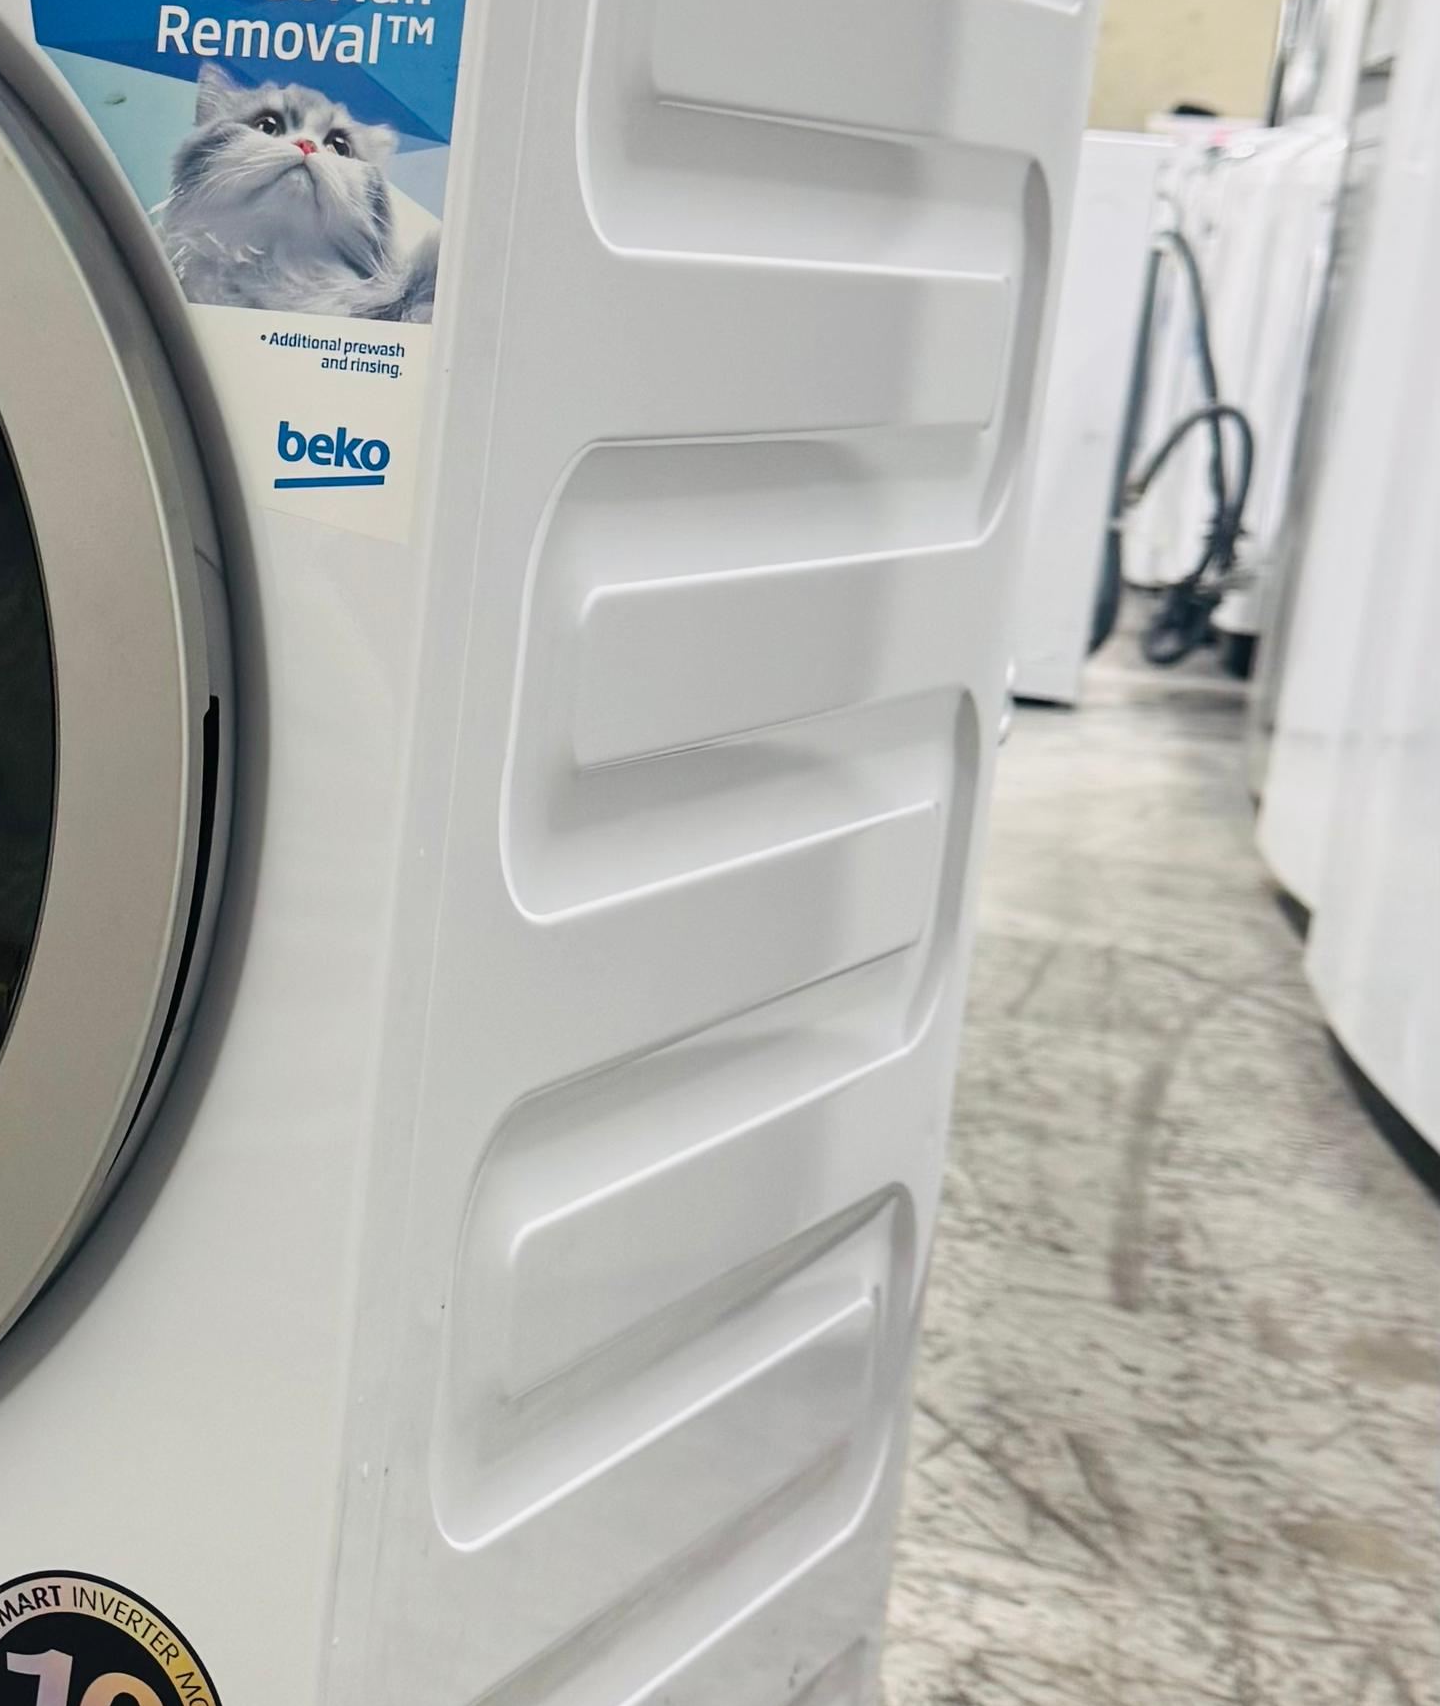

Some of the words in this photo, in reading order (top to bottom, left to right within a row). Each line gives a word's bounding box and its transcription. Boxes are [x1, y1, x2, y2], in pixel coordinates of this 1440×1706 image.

[269, 331, 342, 352] Additional
[343, 340, 405, 358] prewash
[321, 356, 348, 371] and
[350, 357, 403, 379] rinsing.
[276, 420, 392, 474] beko
[72, 1585, 180, 1666] INVERTER
